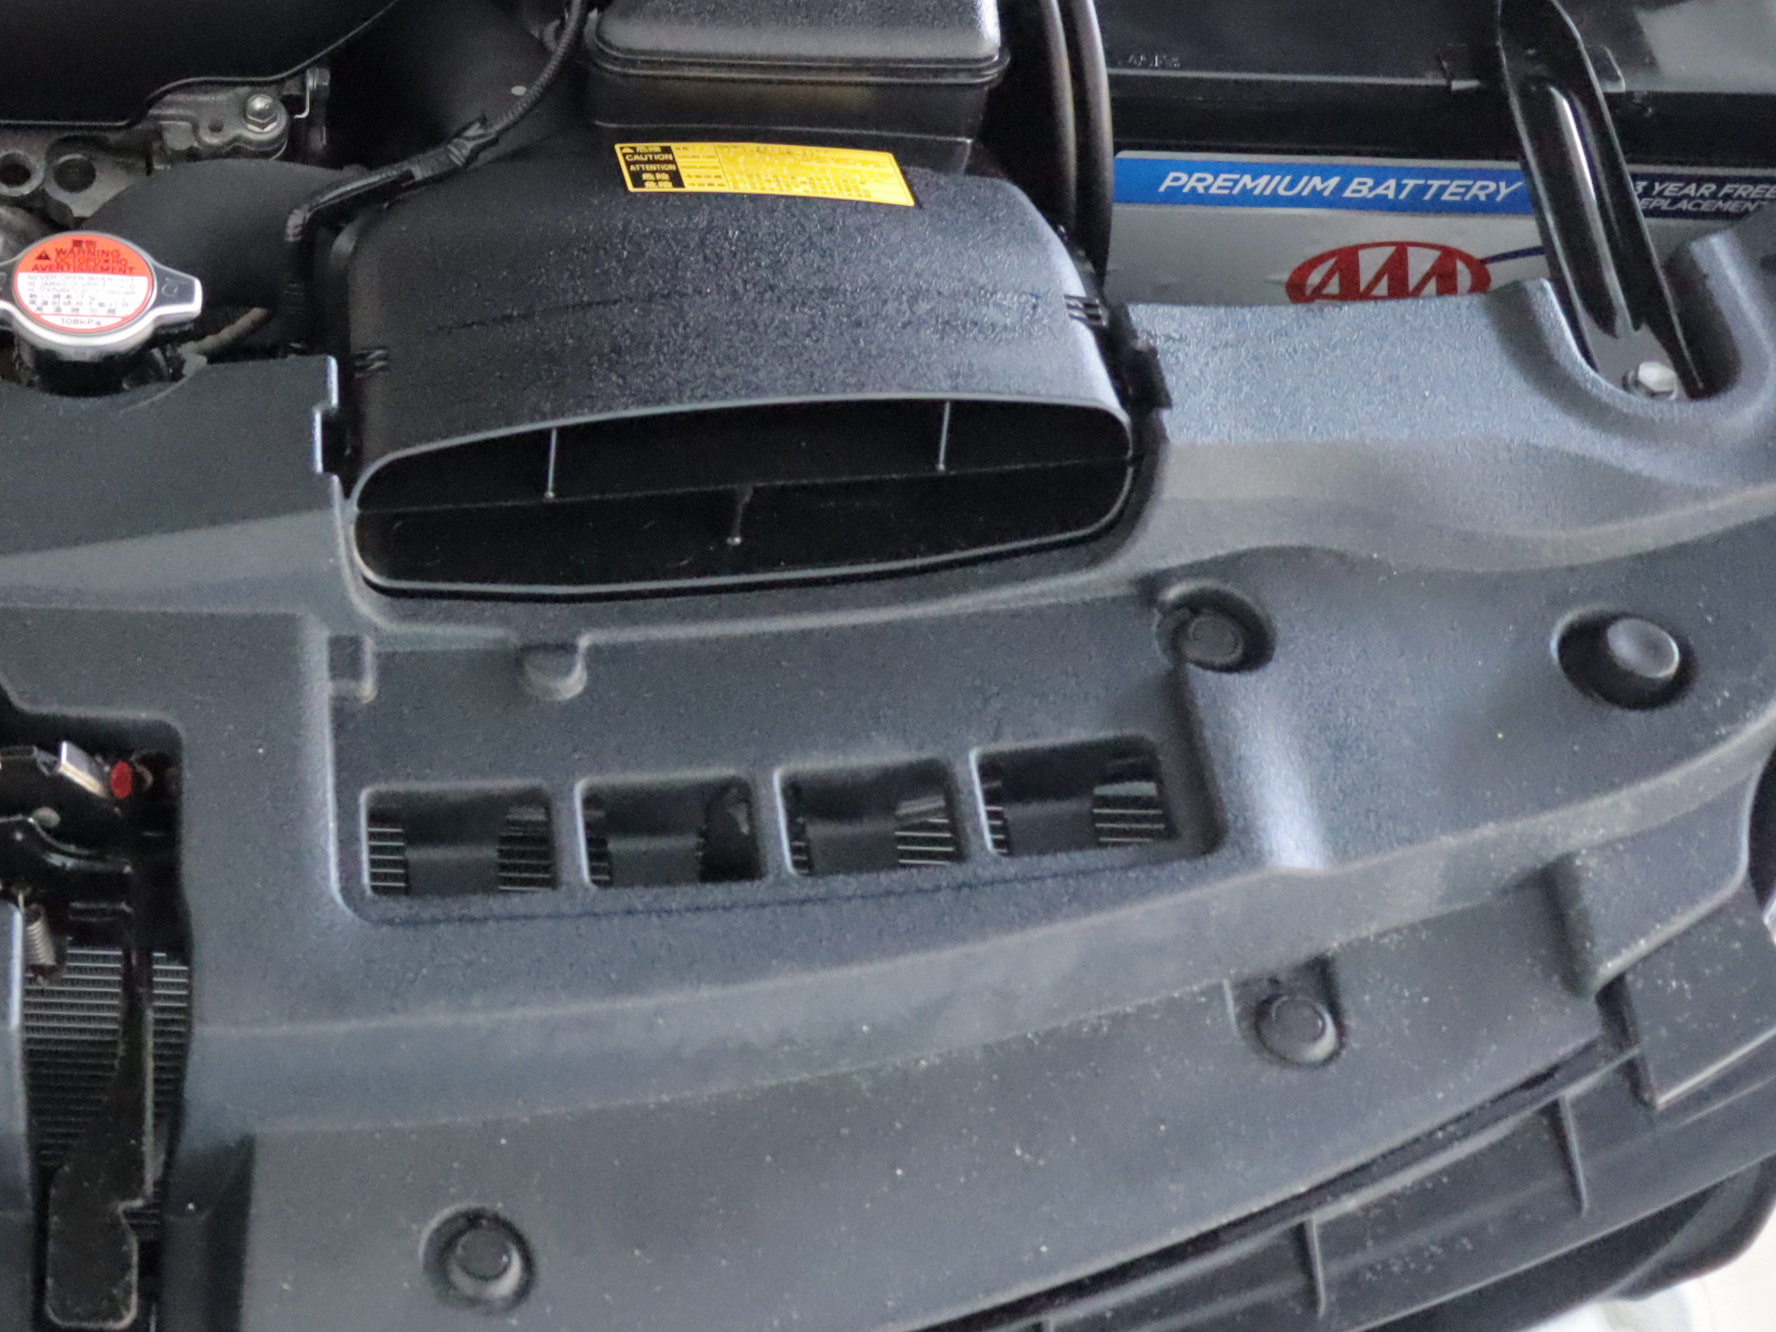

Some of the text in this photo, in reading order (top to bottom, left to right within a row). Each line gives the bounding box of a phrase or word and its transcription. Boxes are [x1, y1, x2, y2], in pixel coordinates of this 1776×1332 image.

[625, 153, 673, 161] CAUTION
[630, 163, 677, 171] ATTENTION
[1158, 171, 1523, 202] PREMIUM BATTERY
[1651, 182, 1717, 197] YEAR
[1718, 183, 1776, 199] FREE
[1639, 198, 1769, 213] EPLACEMEN
[55, 248, 121, 258] WARNING
[1297, 242, 1469, 302] AAA
